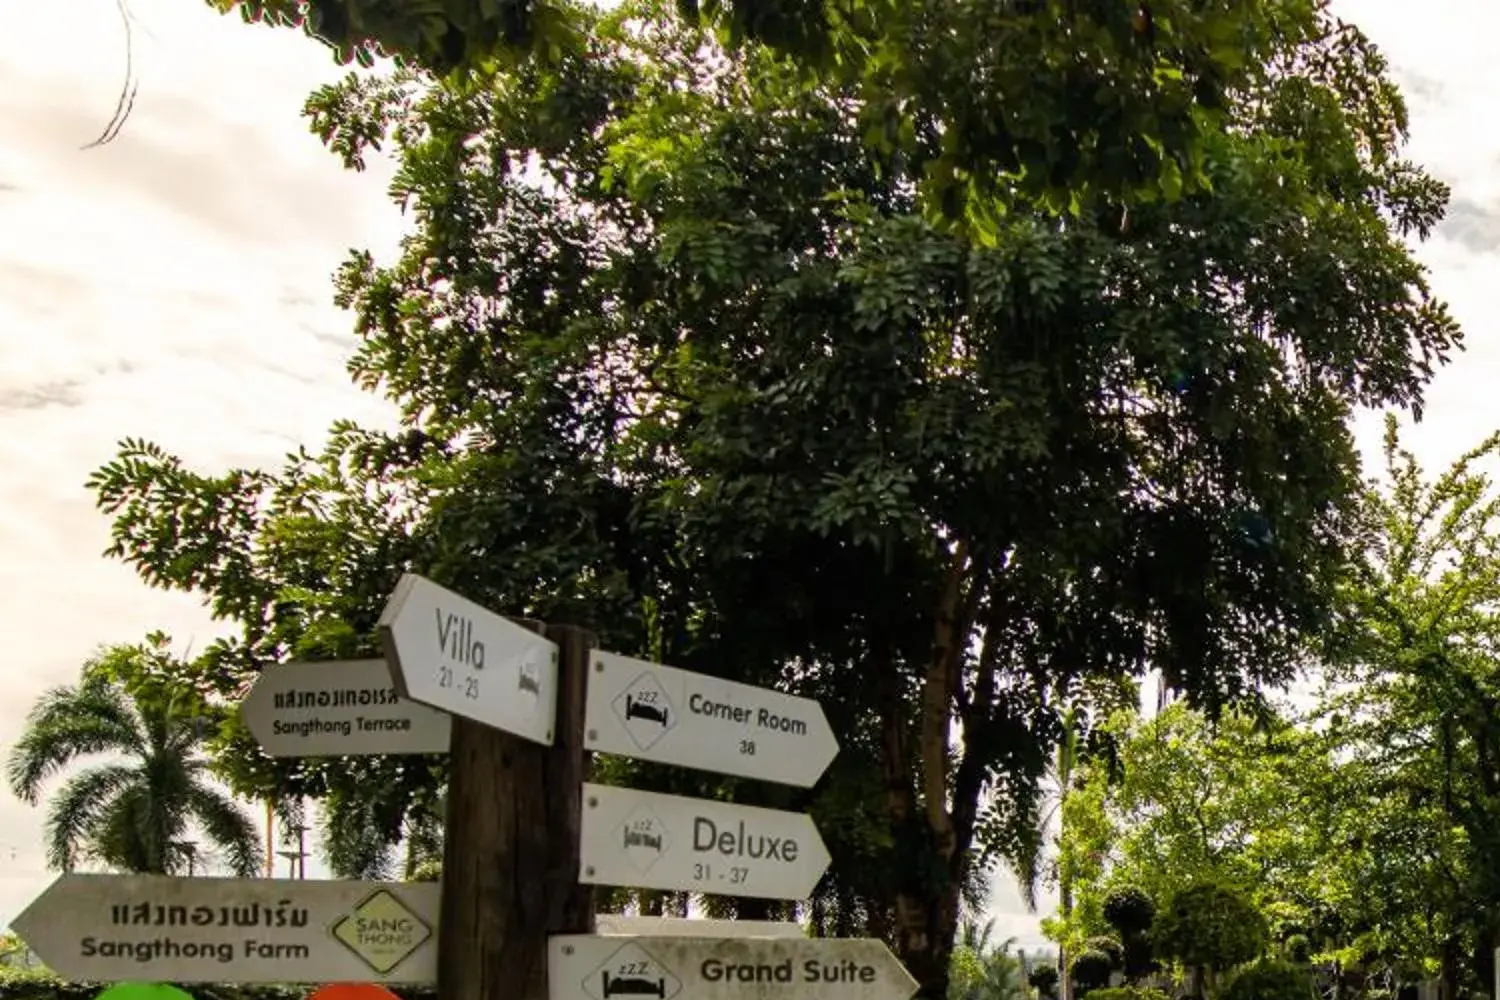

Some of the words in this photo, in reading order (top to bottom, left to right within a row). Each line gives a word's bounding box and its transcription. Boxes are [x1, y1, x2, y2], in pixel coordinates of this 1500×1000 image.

[435, 607, 485, 670] Villa
[272, 717, 351, 736] Sangthong
[356, 716, 411, 732] Terrace
[689, 693, 752, 724] Corner
[757, 708, 807, 735] Room
[692, 815, 799, 862] Deluxe
[693, 863, 711, 881] 31
[730, 866, 749, 884] 37
[112, 898, 309, 928] แสงทองฟาร์ม
[356, 917, 414, 932] SANG
[80, 936, 234, 962] Sangthong
[245, 939, 310, 959] Farm
[356, 933, 413, 946] THONG
[701, 959, 793, 984] Grand
[803, 959, 877, 984] Suite
